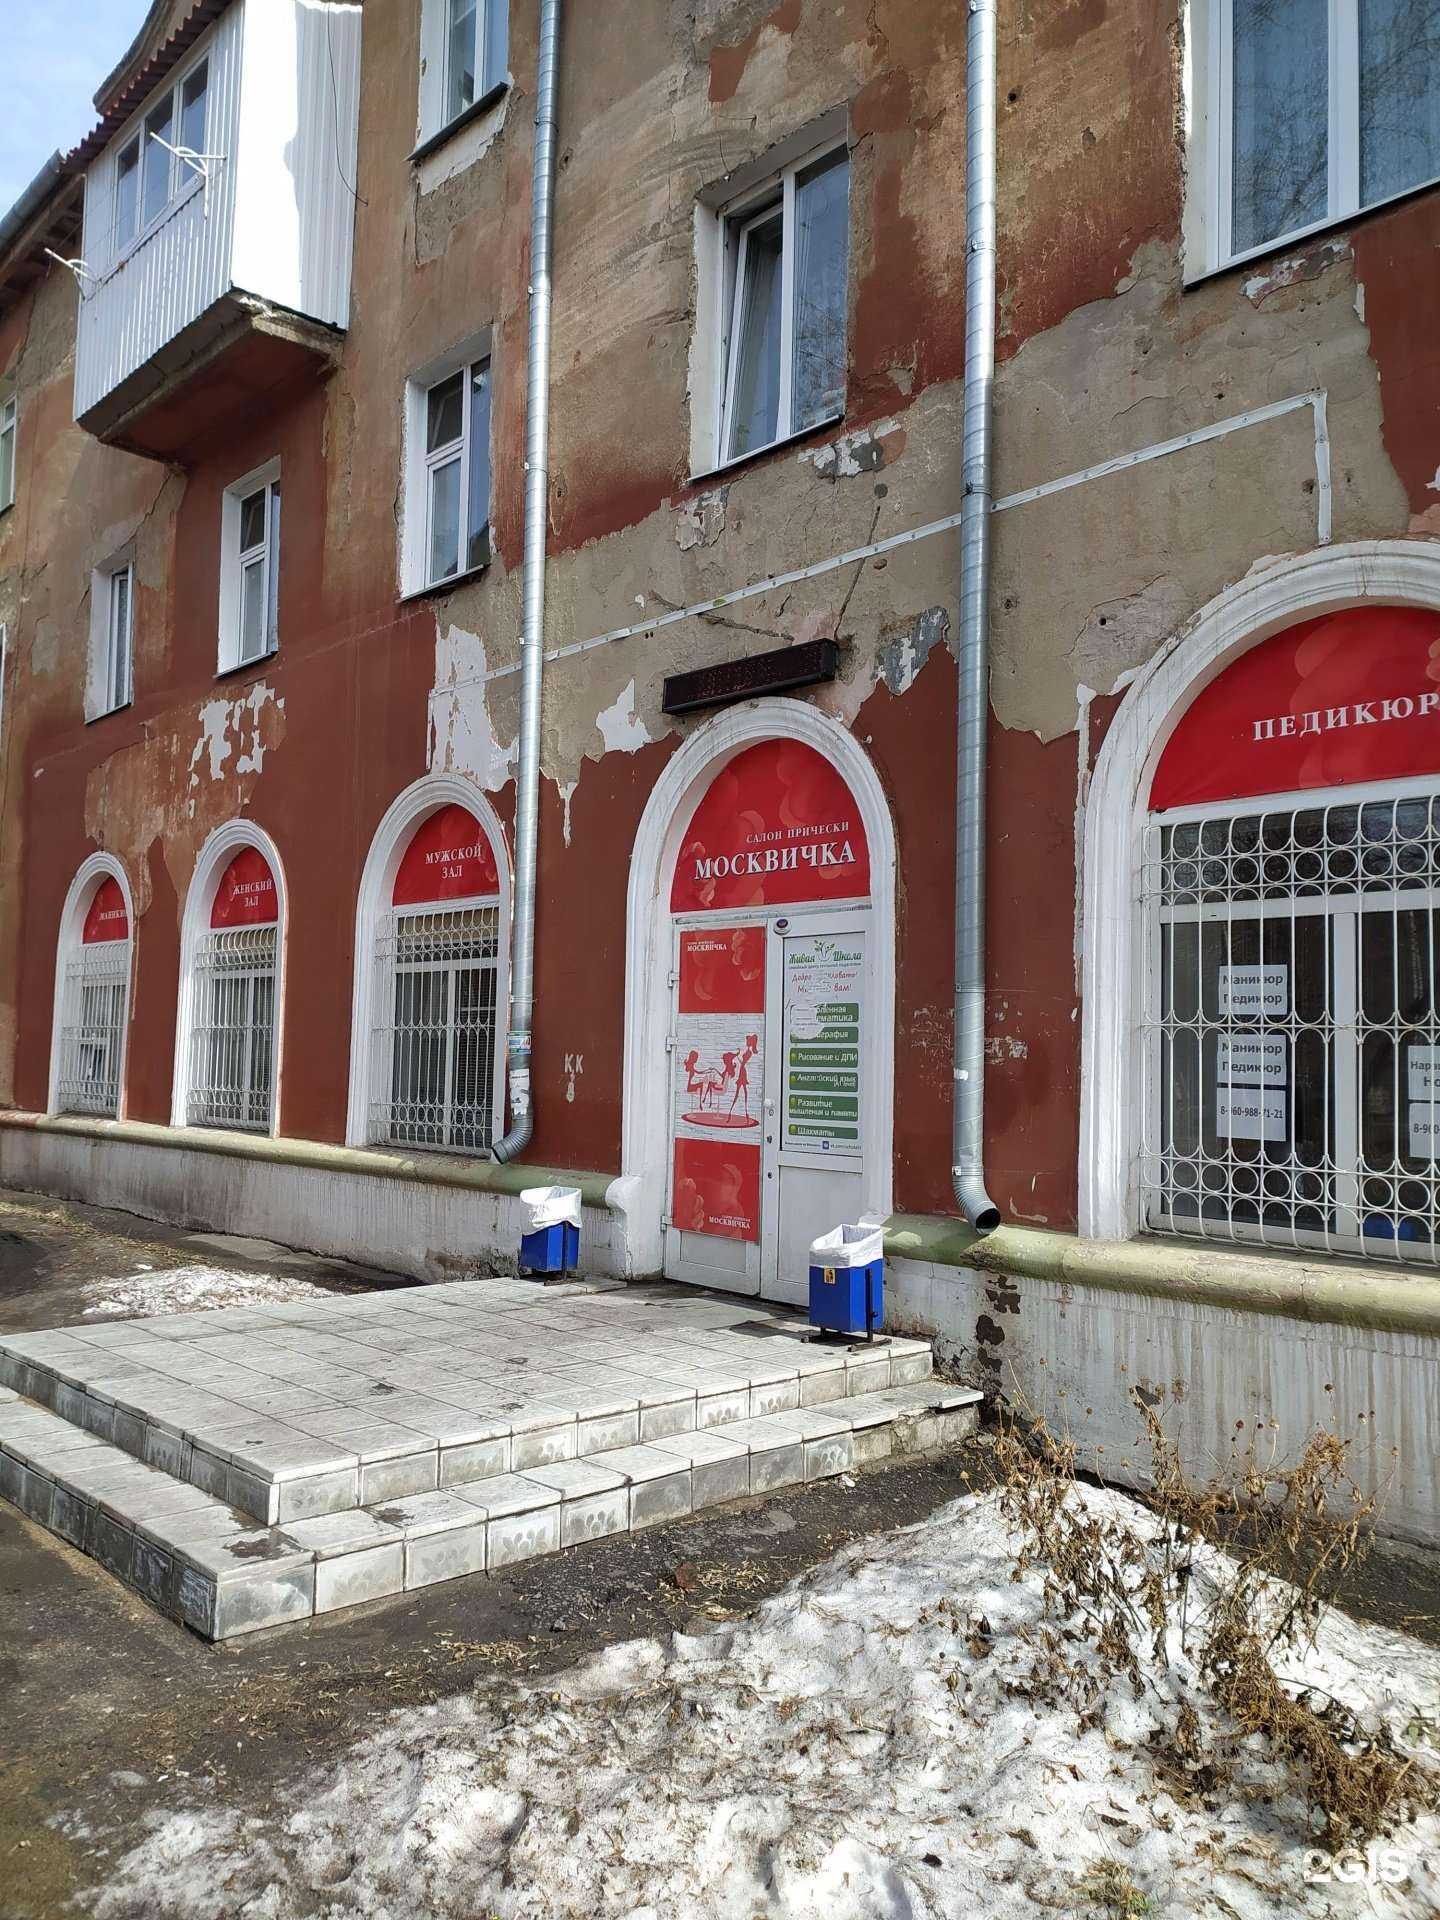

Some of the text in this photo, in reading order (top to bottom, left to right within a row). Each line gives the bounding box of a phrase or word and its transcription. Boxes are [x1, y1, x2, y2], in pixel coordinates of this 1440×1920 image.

[1252, 692, 1440, 741] ПЕДИКЮР
[746, 821, 849, 844] САЛОН ПРИЧЕСКИ
[425, 843, 481, 864] МУЖСКОЙ
[694, 839, 856, 880] МОСКВИЧКА
[441, 865, 462, 879] ЗАЛ
[232, 879, 272, 895] ЖЕНСКИЙ
[244, 897, 259, 907] ЗАЛ
[687, 943, 727, 952] МОСКВИЧКА
[832, 950, 862, 961] Школа
[708, 1216, 751, 1230] МОСКВИЧКА
